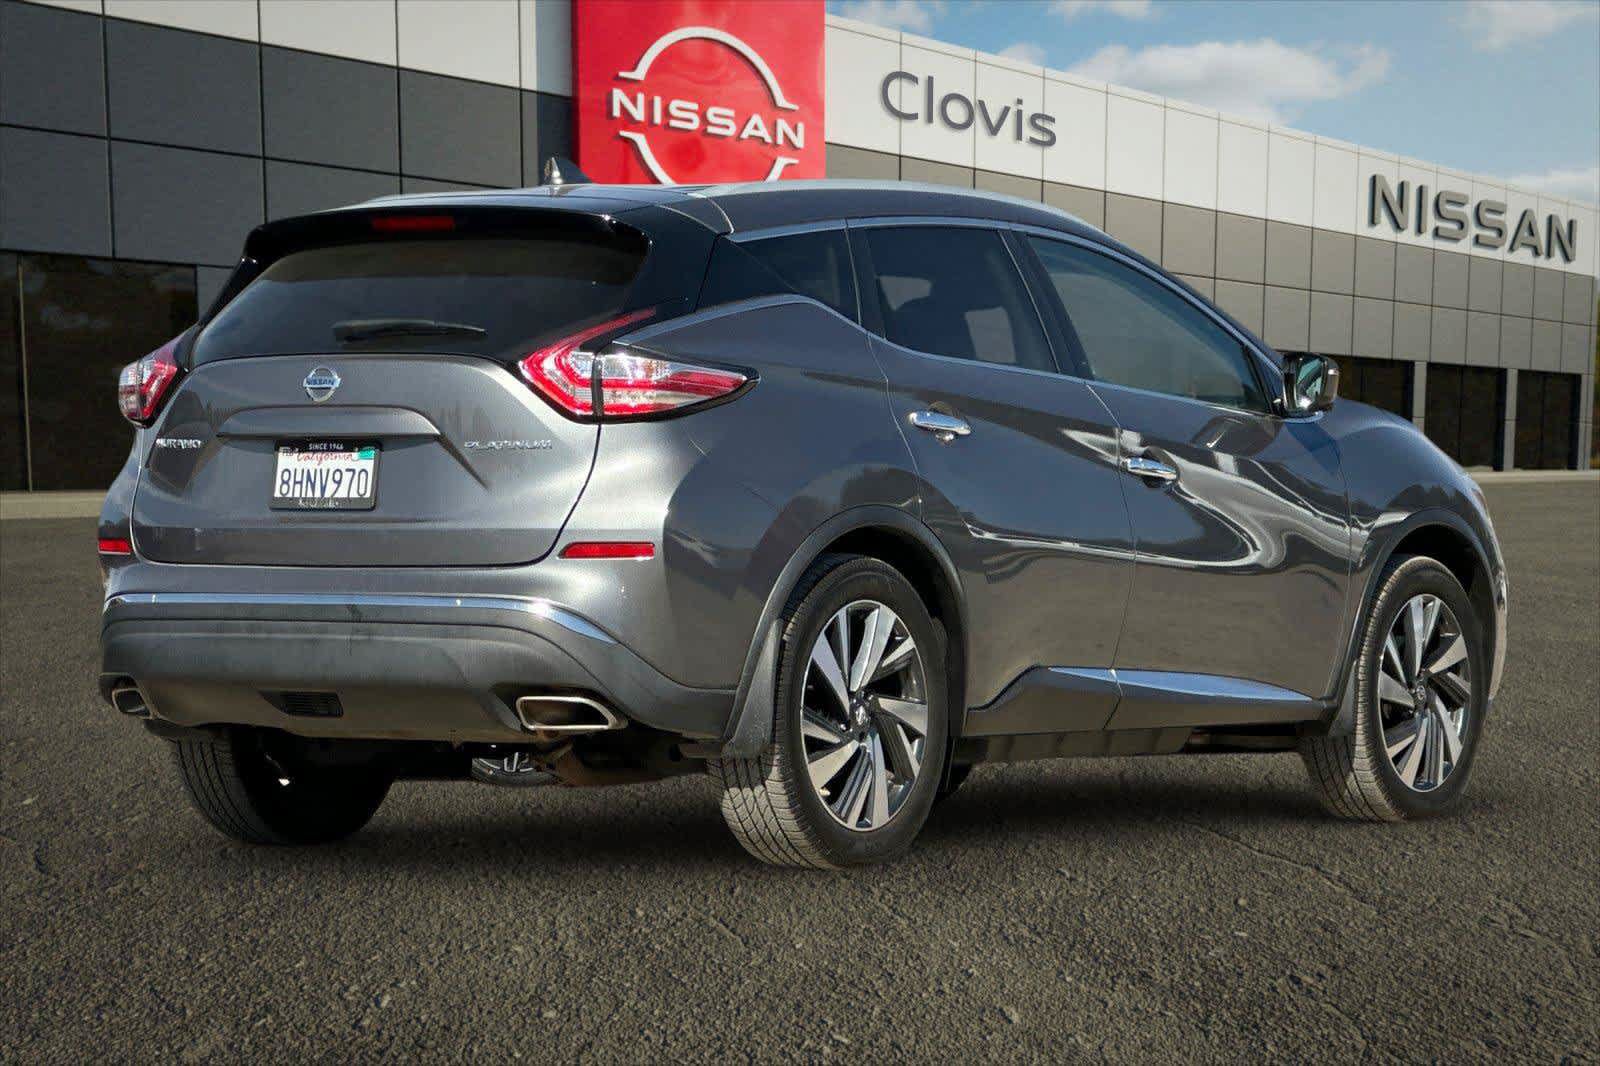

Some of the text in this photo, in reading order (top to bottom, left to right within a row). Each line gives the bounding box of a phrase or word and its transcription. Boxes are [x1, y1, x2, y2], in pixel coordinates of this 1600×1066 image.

[611, 87, 805, 149] NISSAN
[881, 71, 1058, 147] Clovis
[1368, 173, 1577, 263] NISSAN
[279, 468, 369, 499] 8HNV970
